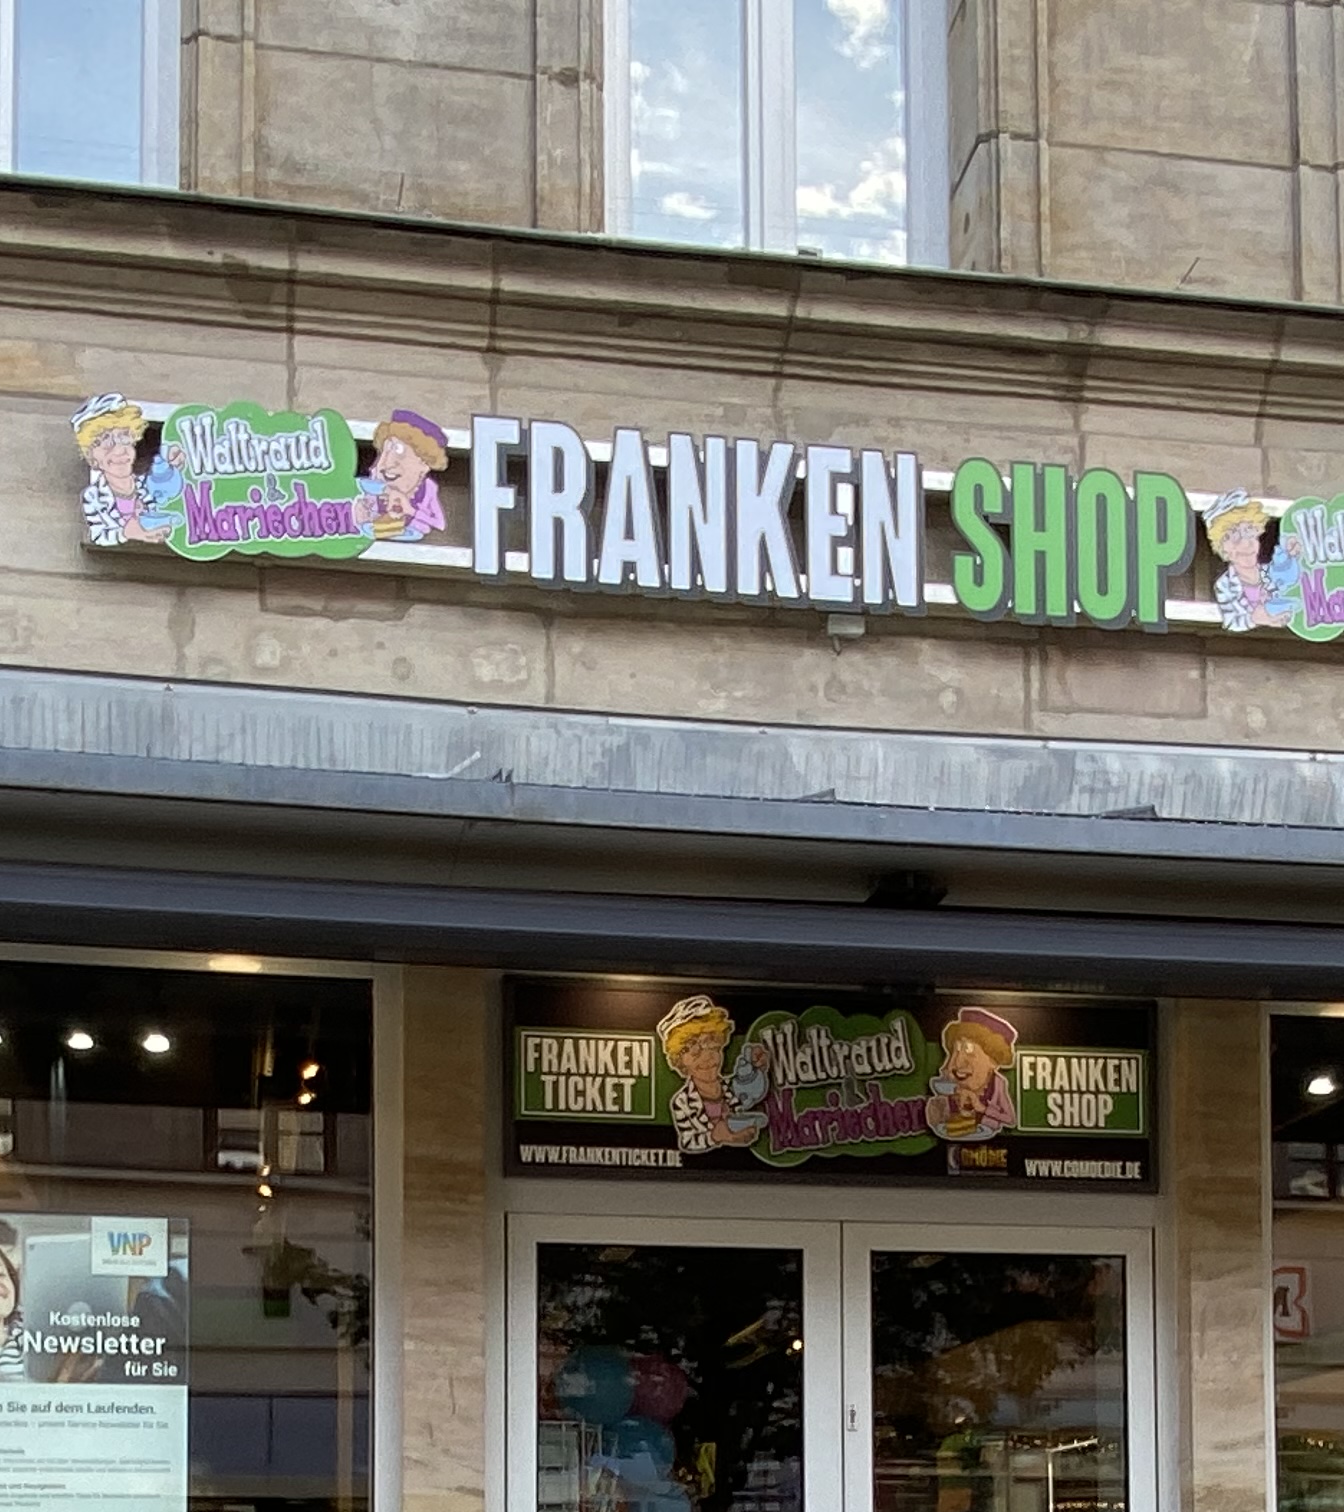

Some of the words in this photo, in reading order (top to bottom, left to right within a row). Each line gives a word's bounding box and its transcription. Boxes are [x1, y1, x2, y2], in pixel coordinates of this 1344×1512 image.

[179, 413, 331, 476] Waltraud
[265, 473, 285, 501] &
[183, 480, 361, 545] Mariechen
[470, 413, 923, 608] FRANKEN
[953, 457, 1192, 627] SHOP
[526, 1037, 650, 1077] FRANKEN
[761, 1017, 913, 1086] Waltraud
[1021, 1055, 1137, 1093] FRANKEN
[541, 1074, 637, 1112] TICKET
[1046, 1092, 1114, 1128] SHOP
[519, 1143, 684, 1168] WWW.FRANKENTICKET.DE
[107, 1230, 152, 1257] VNP
[48, 1310, 140, 1327] Kostenlose
[22, 1330, 166, 1355] Newsletter
[124, 1360, 149, 1377] für
[152, 1361, 178, 1378] Sie
[6, 1401, 28, 1413] Sie
[30, 1401, 52, 1414] auf
[54, 1401, 83, 1414] dem
[86, 1402, 158, 1415] Laufenden.
